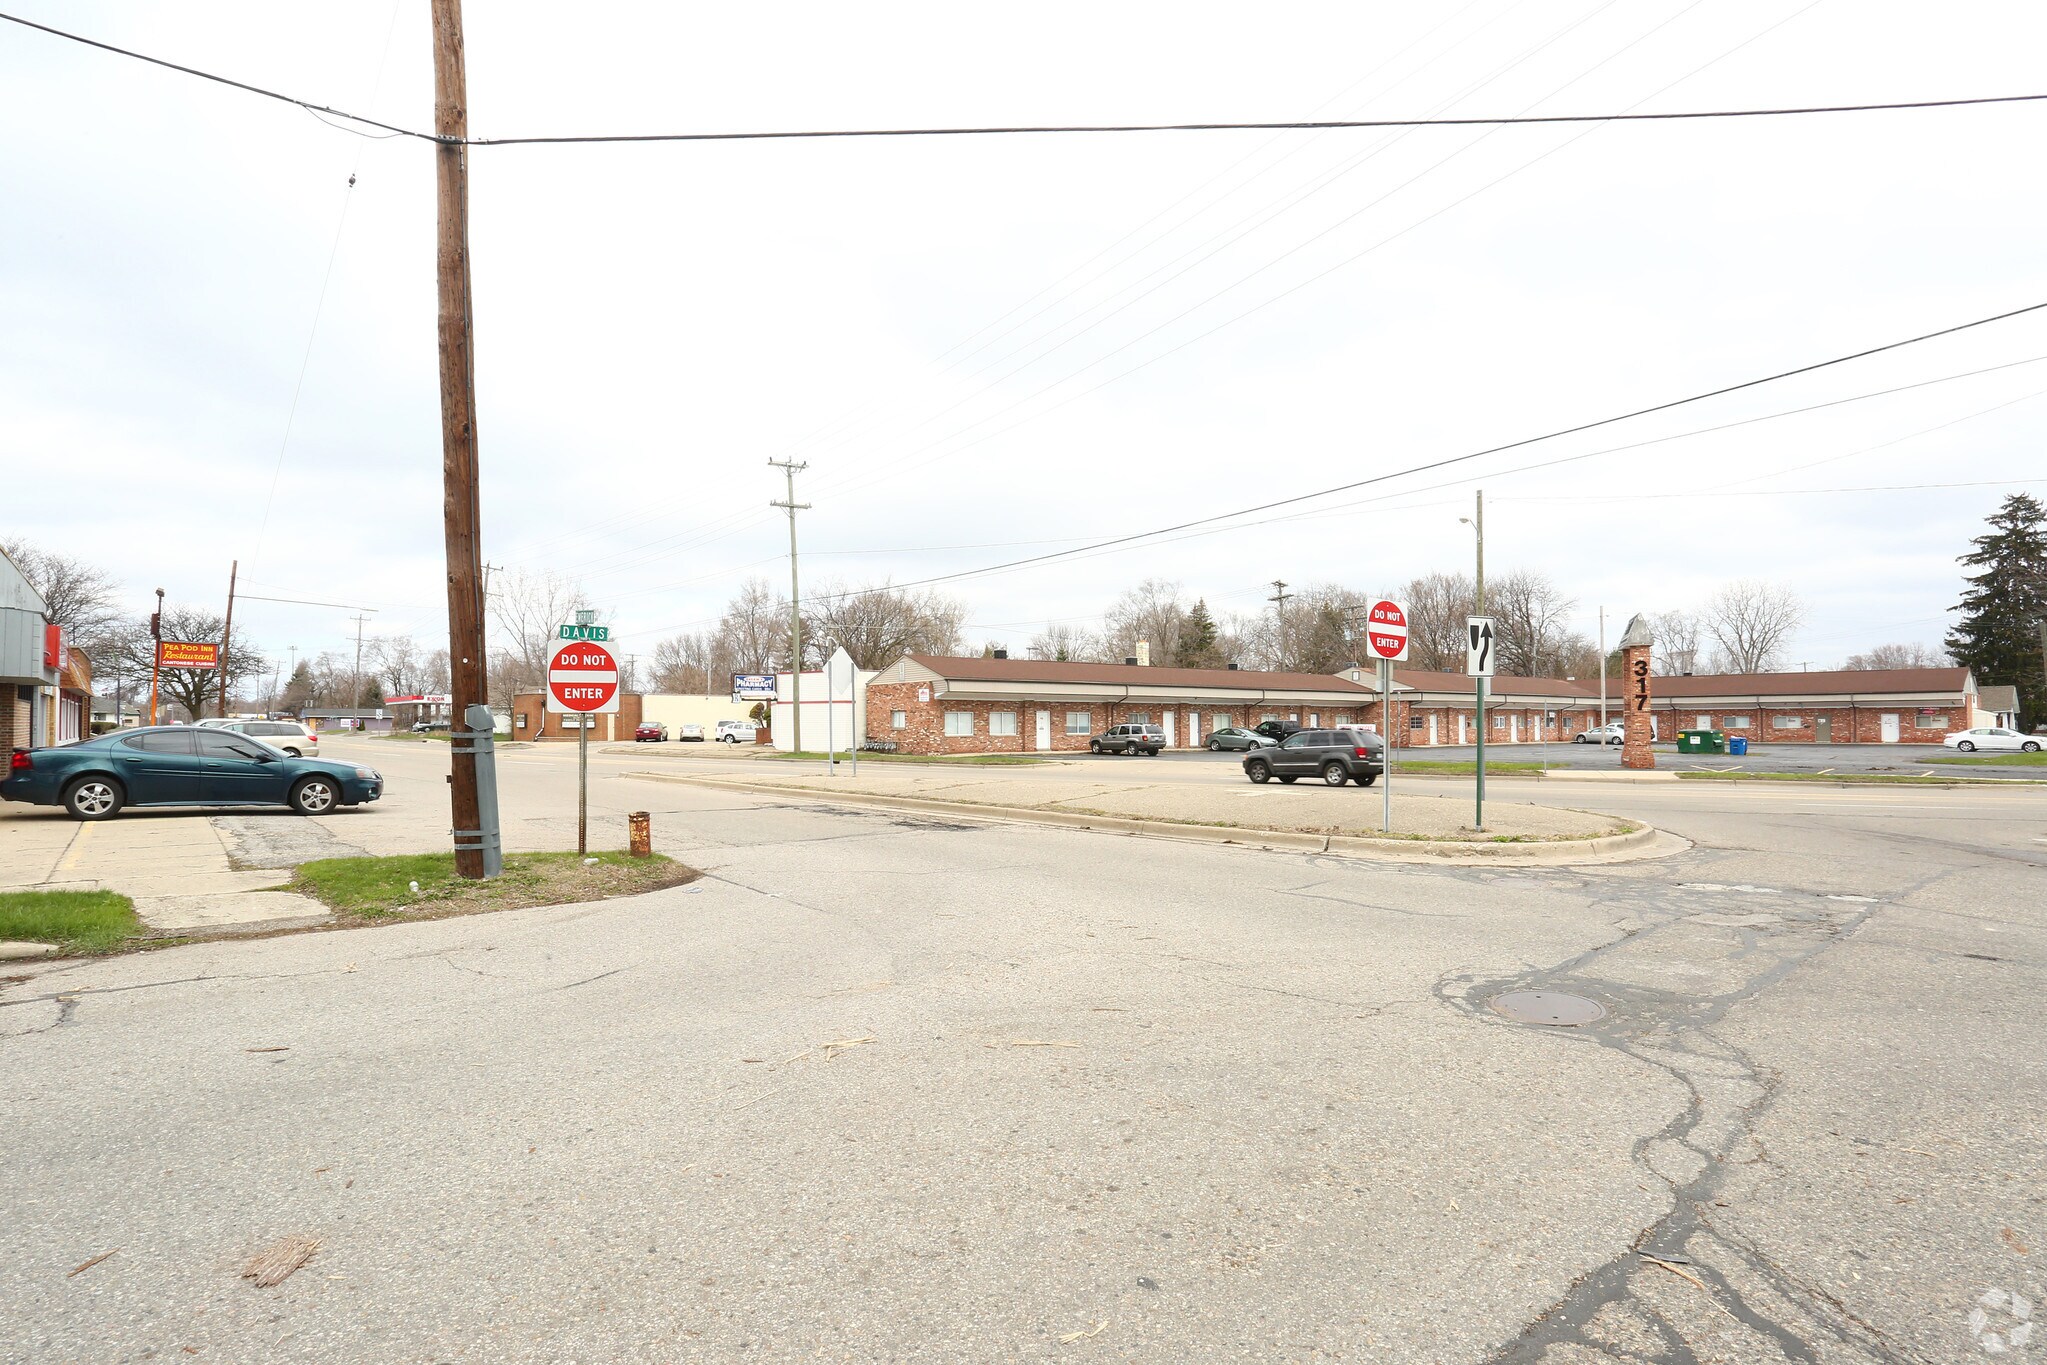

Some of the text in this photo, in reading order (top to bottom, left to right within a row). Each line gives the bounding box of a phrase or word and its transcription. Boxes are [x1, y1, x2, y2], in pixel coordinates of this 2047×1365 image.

[1374, 609, 1401, 622] DO NOT
[563, 626, 605, 639] DAVIS
[1376, 637, 1399, 649] ENTER
[163, 650, 214, 661] Restaurant
[561, 654, 606, 666] DO NOT
[736, 677, 773, 688] PHARMACY
[1634, 660, 1648, 711] 317
[564, 687, 603, 699] ENTER
